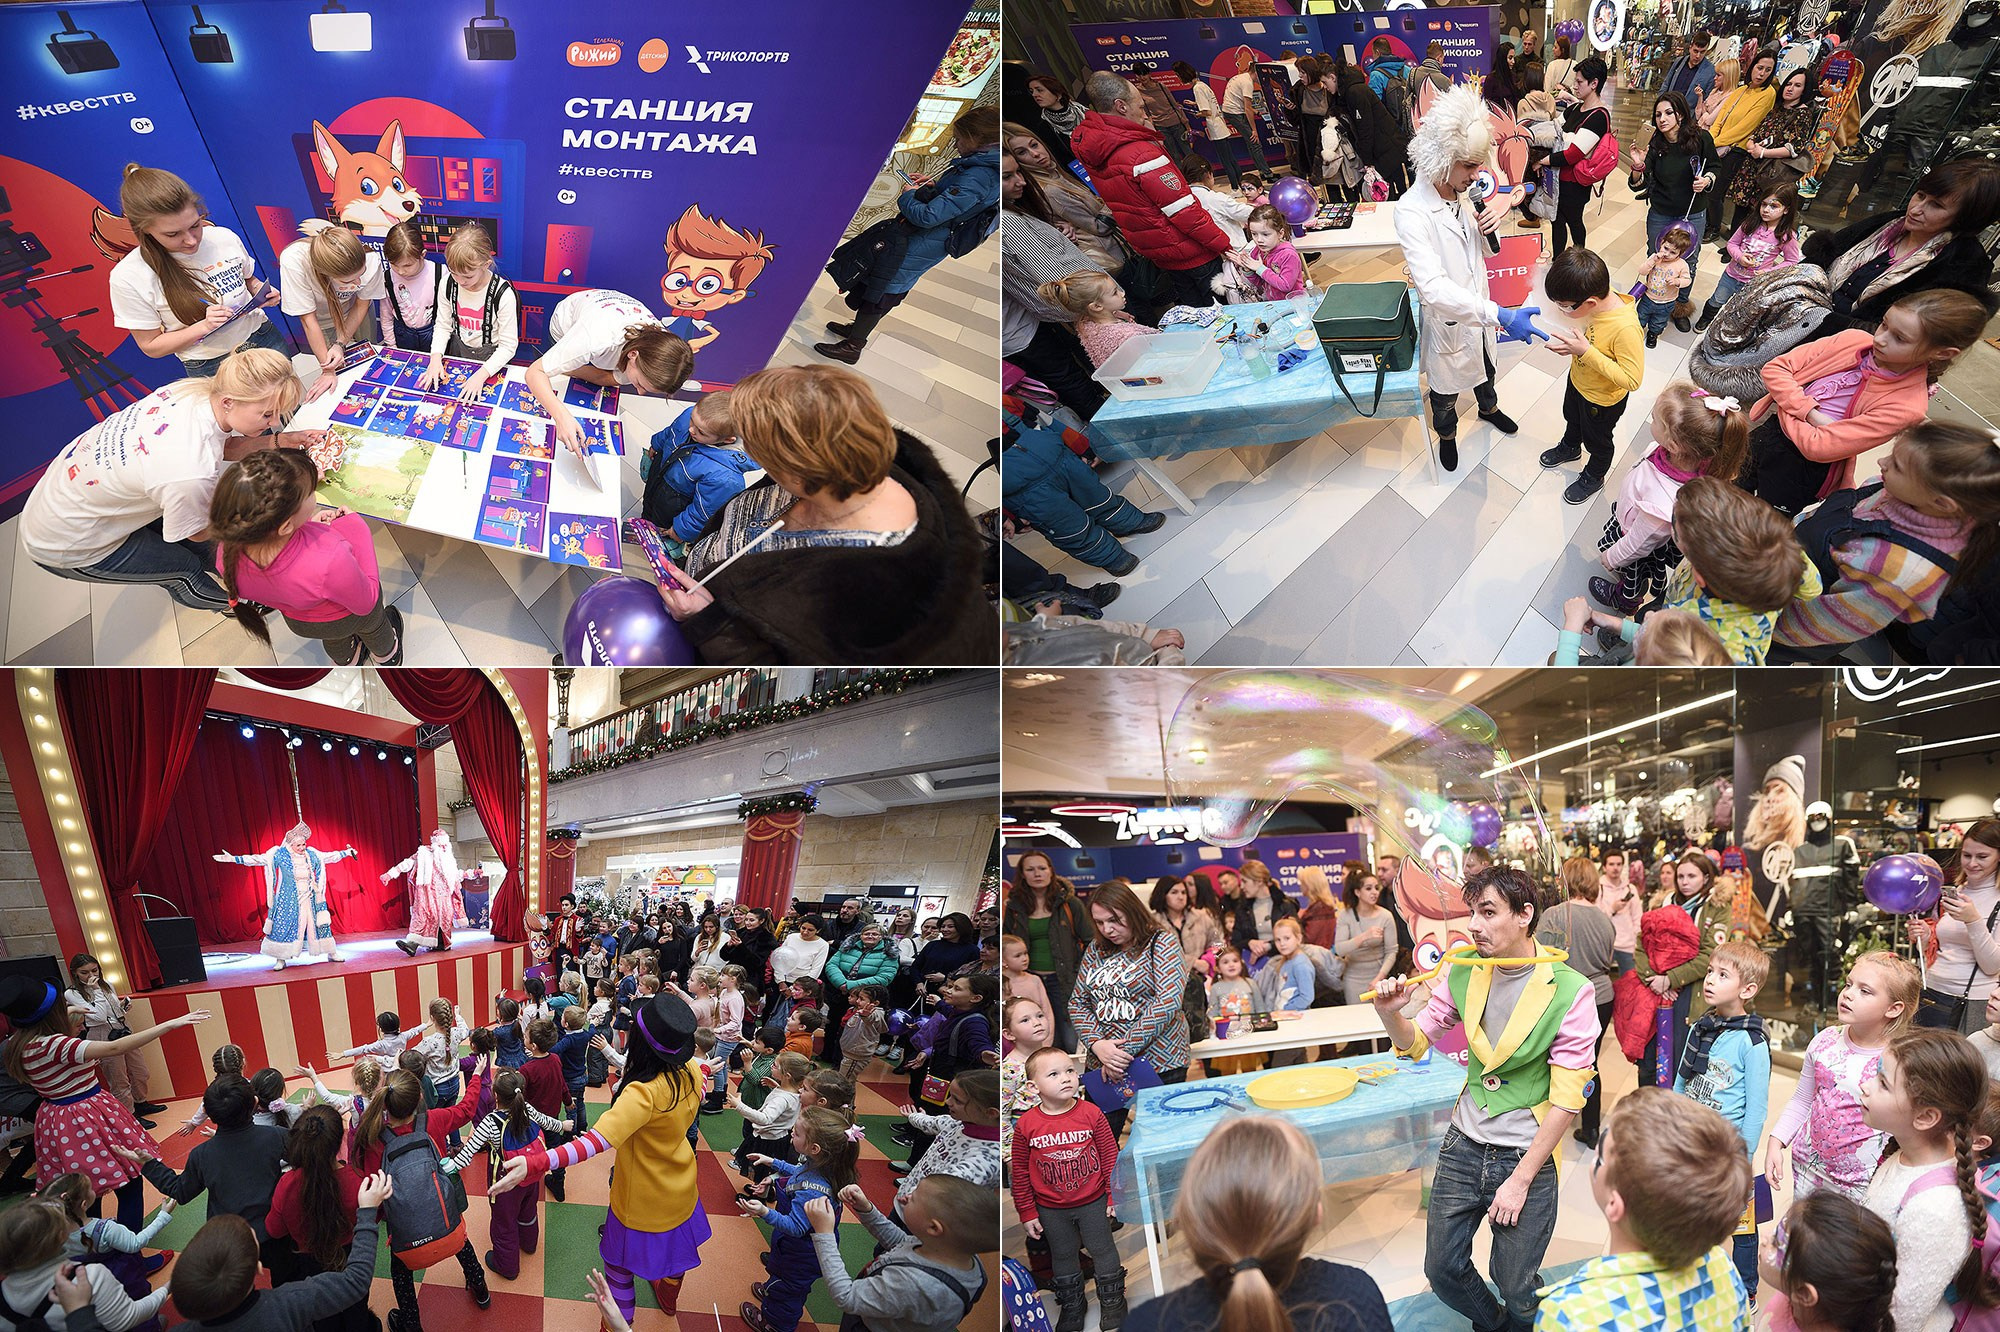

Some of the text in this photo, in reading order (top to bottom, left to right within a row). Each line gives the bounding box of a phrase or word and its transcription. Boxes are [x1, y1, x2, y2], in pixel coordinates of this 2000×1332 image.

[963, 12, 981, 22] RIA
[706, 51, 790, 62] ТРИКОЛОРТВ
[1106, 50, 1170, 62] СТАНЦИЯ
[1444, 49, 1483, 57] ИКОЛОР
[1110, 61, 1158, 72] РАО
[564, 98, 754, 123] СТАНЦИЯ
[135, 121, 150, 130] 0+
[562, 130, 758, 155] МОНТАЖА
[588, 621, 614, 666] ОЛОРТВ
[1096, 997, 1135, 1022] echo
